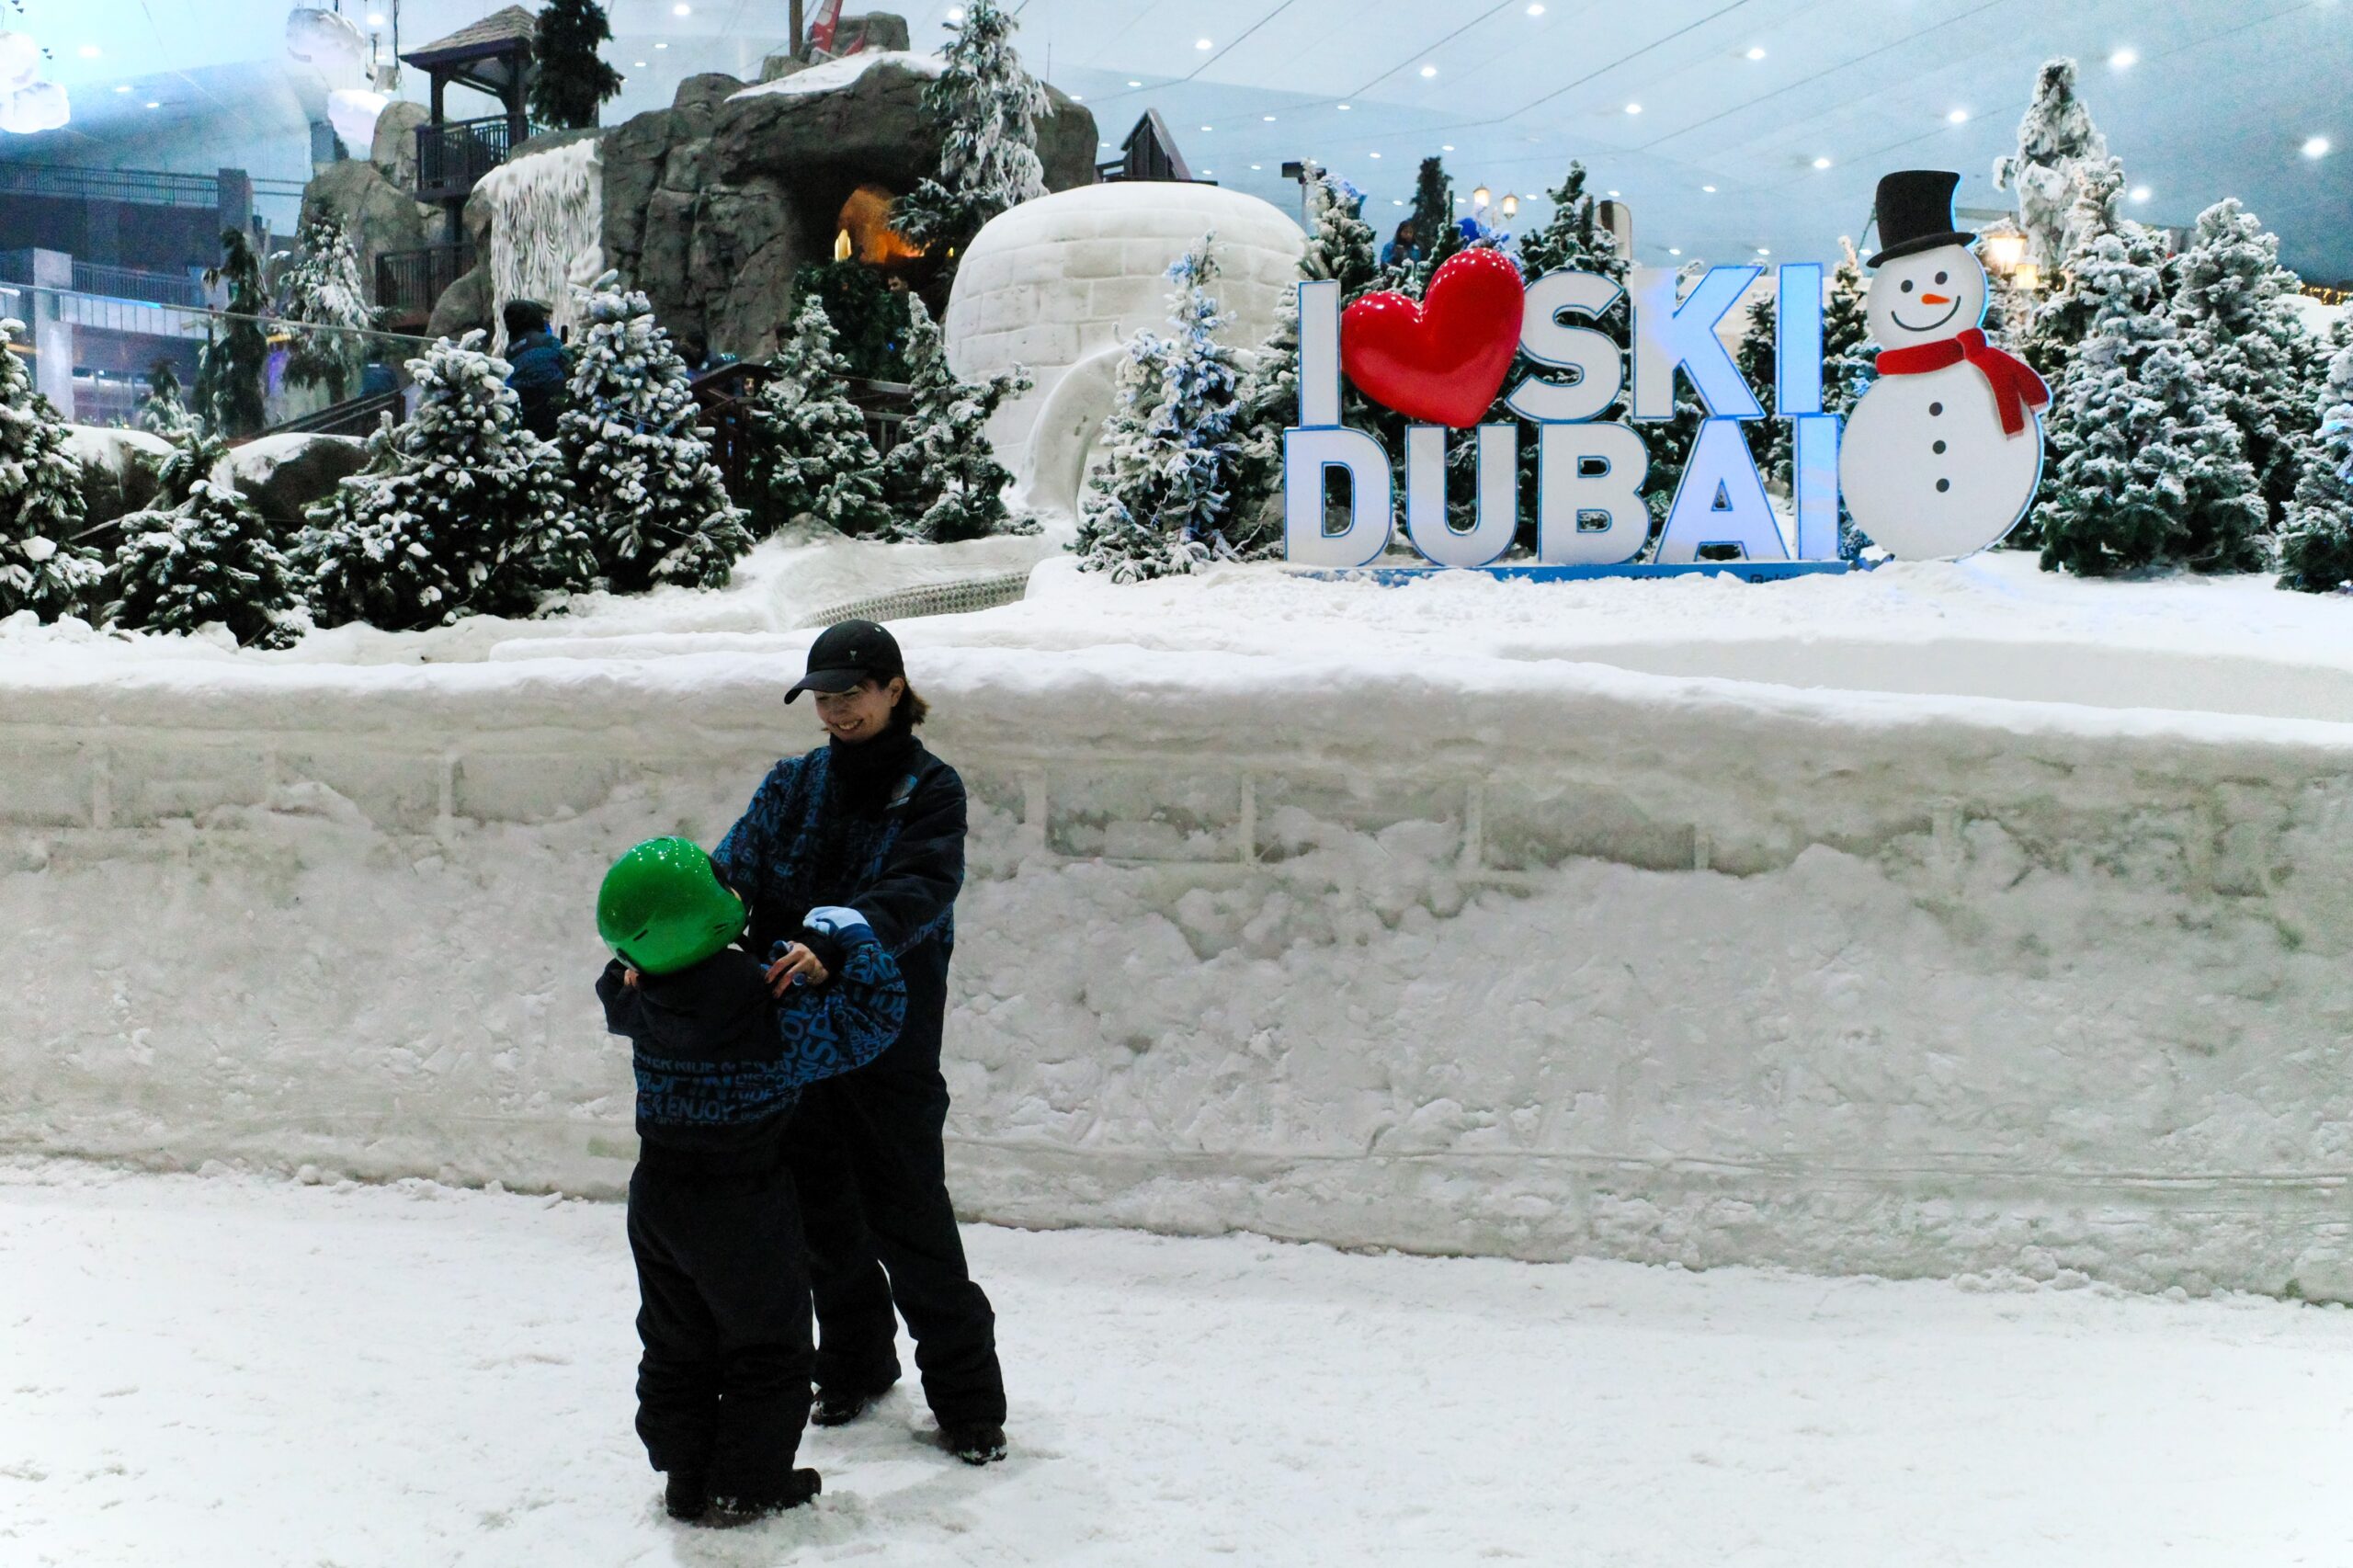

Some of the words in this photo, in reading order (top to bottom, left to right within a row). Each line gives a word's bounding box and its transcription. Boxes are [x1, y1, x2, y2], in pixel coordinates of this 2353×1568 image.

[1299, 278, 1341, 426] I
[1505, 262, 1824, 422] SKI
[1283, 414, 1839, 566] DUBAI
[665, 1096, 737, 1120] ENJOY
